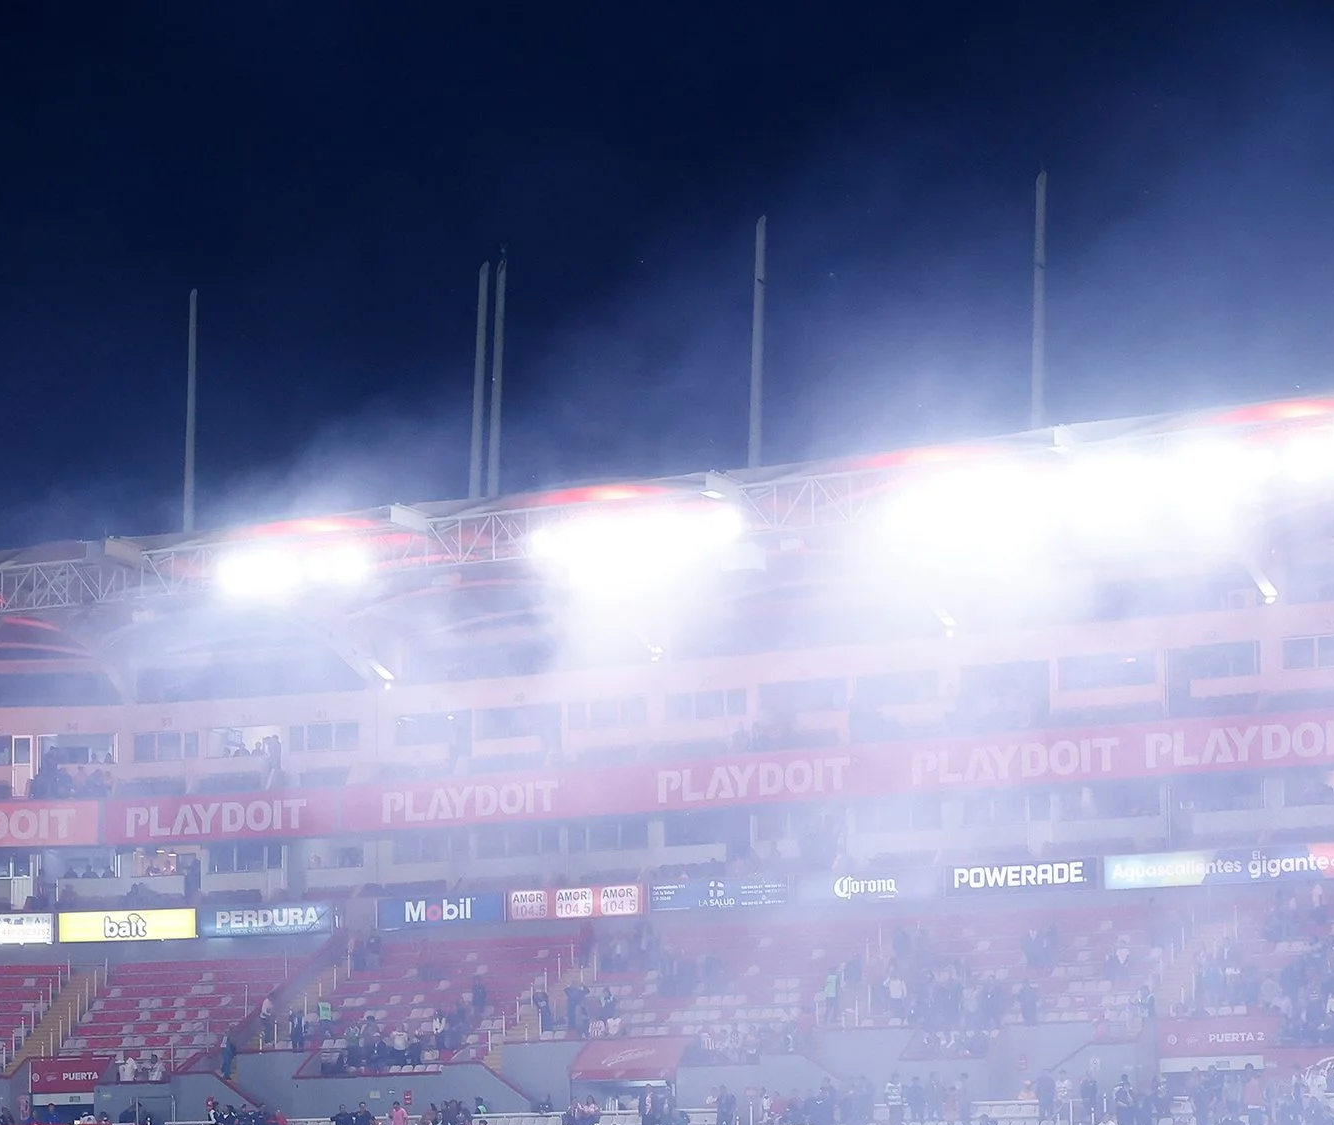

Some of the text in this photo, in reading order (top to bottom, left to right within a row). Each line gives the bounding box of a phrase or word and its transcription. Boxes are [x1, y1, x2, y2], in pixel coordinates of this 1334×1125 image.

[911, 736, 1120, 786] PLAYDOIT
[657, 757, 850, 804] PLAYDOIT
[382, 779, 558, 823] PLAYDOIT
[125, 799, 307, 838] PLAYDOIT
[952, 862, 1085, 889] POWERADE
[1112, 858, 1242, 882] Aguascalientes
[1248, 852, 1329, 879] gigante
[512, 893, 543, 904] AMOR
[557, 891, 588, 902] AMOR
[602, 888, 633, 899] AMOR
[834, 875, 899, 900] Corona
[405, 897, 472, 922] Mobil
[515, 902, 546, 917] 104.5
[557, 902, 591, 915] 104.5
[603, 899, 637, 912] 104.5
[104, 912, 147, 938] bait
[217, 907, 319, 928] PERDURA
[1208, 1031, 1265, 1044] PUERTA 2
[62, 1071, 98, 1082] PUERTA
